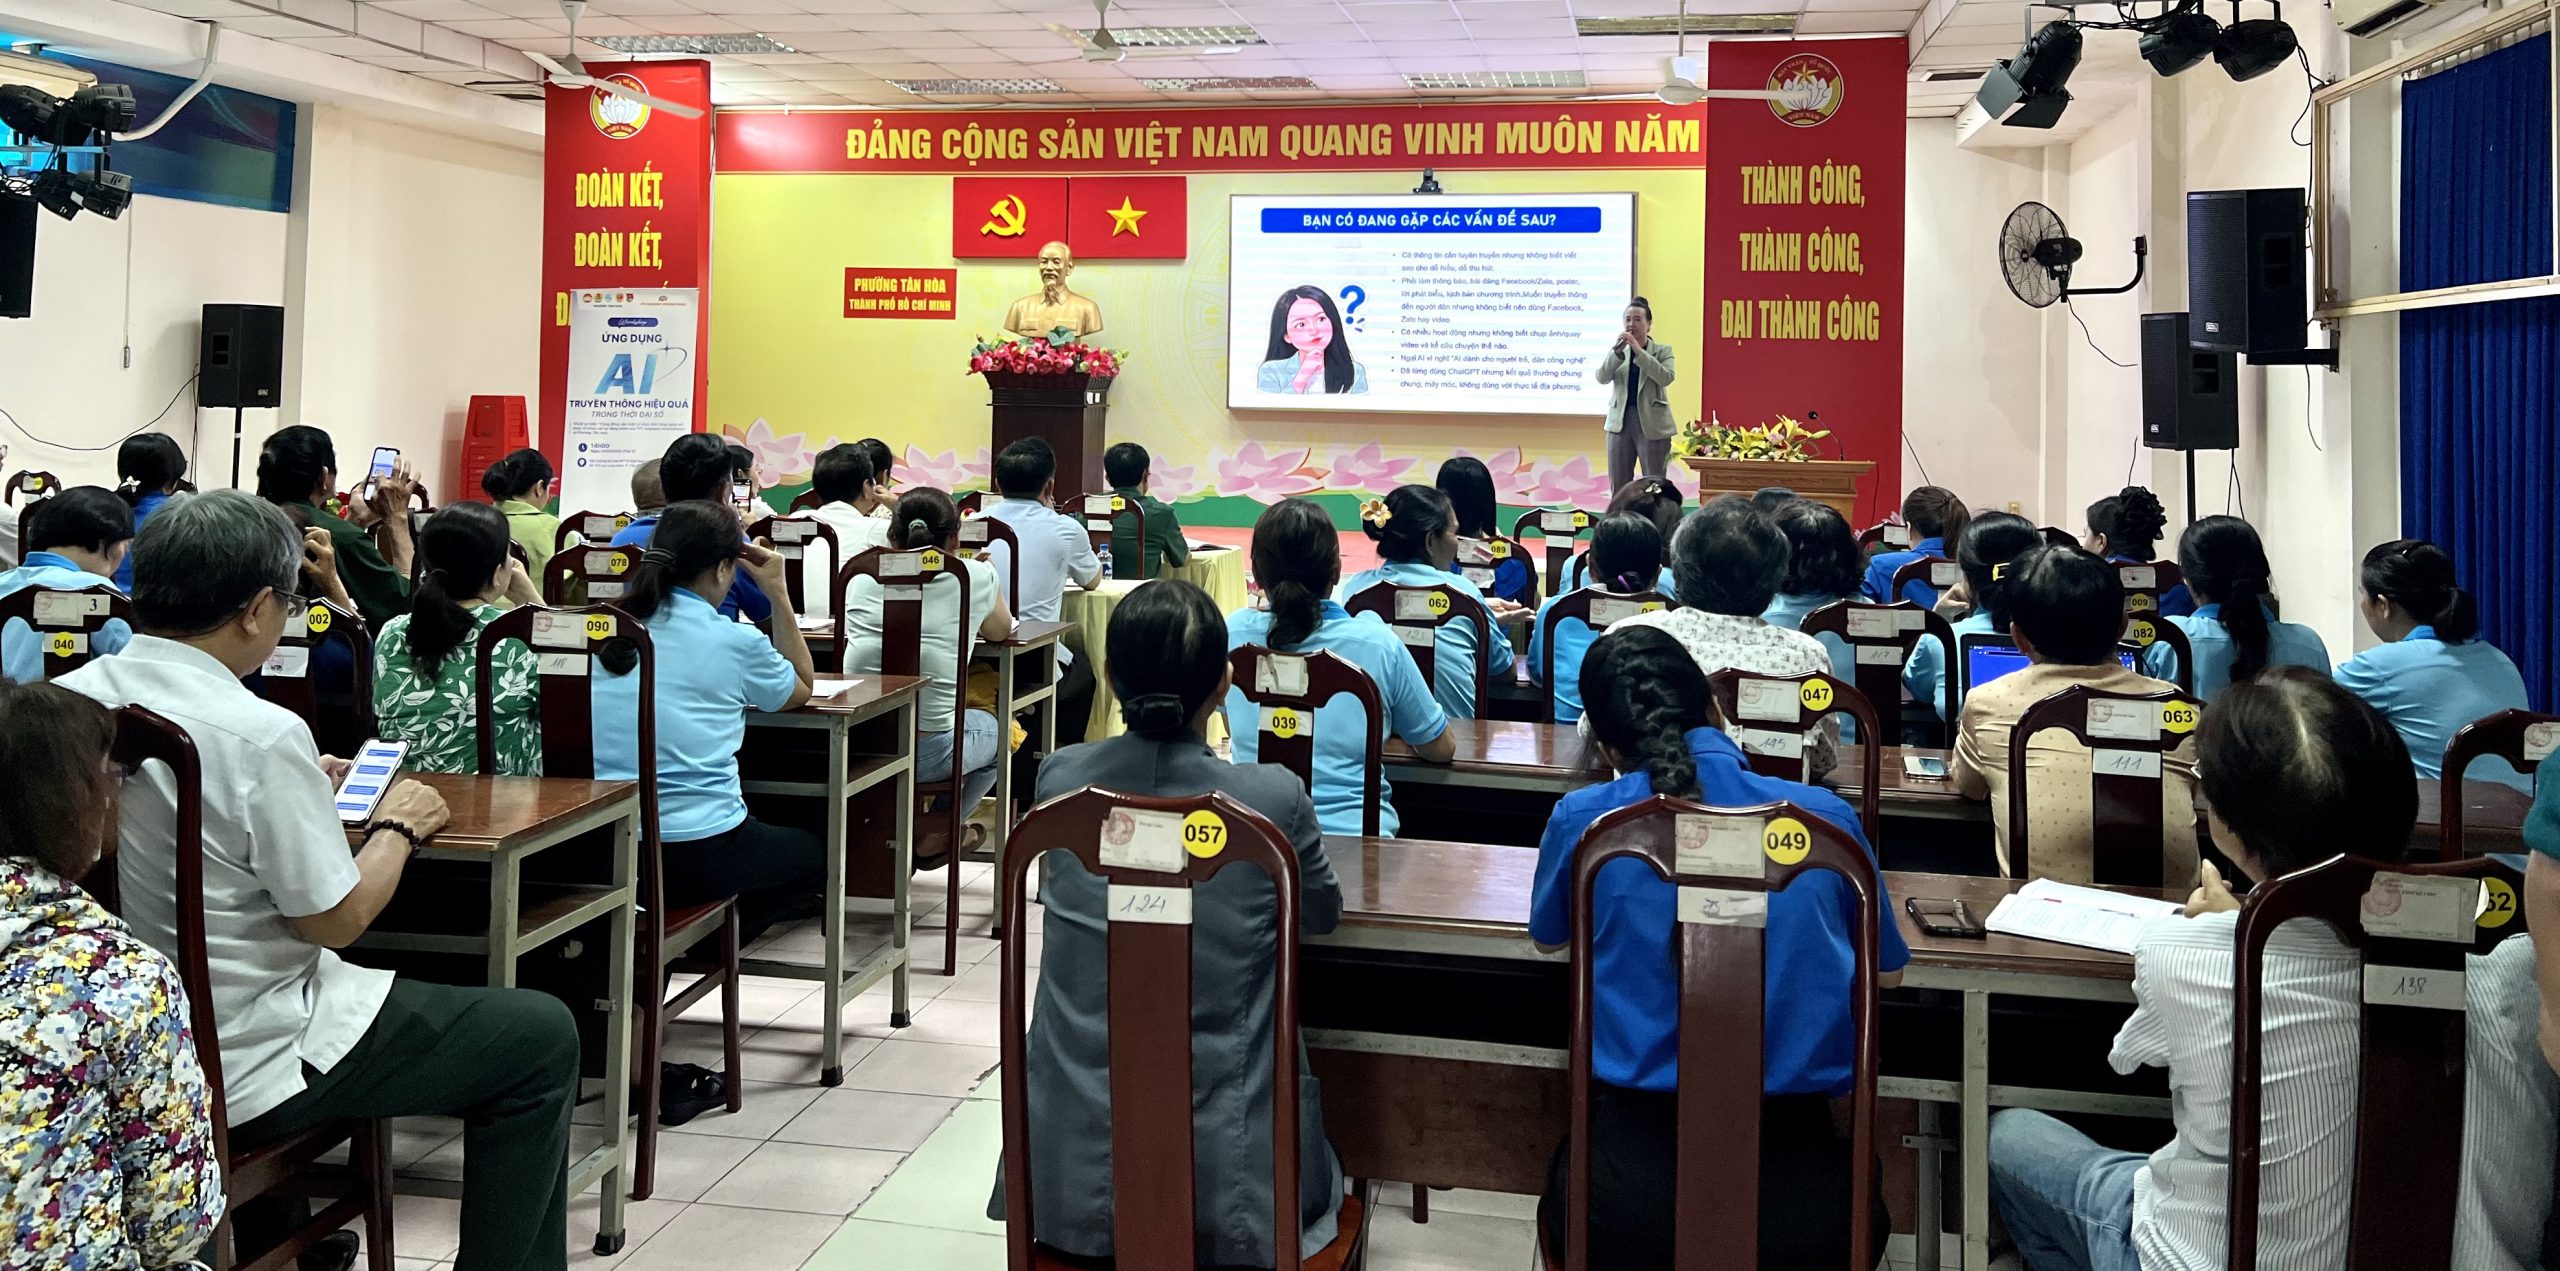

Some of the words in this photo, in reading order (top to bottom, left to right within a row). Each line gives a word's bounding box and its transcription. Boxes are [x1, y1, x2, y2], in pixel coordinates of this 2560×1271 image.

[846, 119, 931, 160] ĐẢNG
[942, 122, 1028, 166] CỘNG
[1038, 118, 1104, 160] SẢN
[1115, 120, 1181, 164] VIỆT
[1192, 125, 1268, 158] NAM
[1280, 123, 1392, 160] QUANG
[1404, 122, 1484, 156] VINH
[1496, 114, 1602, 155] MUÔN
[1615, 113, 1699, 153] NĂM
[576, 167, 624, 208] ĐOÀN
[630, 160, 663, 210] KẾT,
[1741, 160, 1802, 204] THÀNH
[1809, 158, 1865, 208] CÔNG,
[1303, 214, 1331, 230] BẠN
[1336, 212, 1353, 226] CÓ
[1358, 214, 1396, 226] ĐANG
[1401, 212, 1429, 229] GẶP
[1433, 212, 1460, 226] CÁC
[1464, 209, 1492, 226] VẤN
[1521, 214, 1556, 226] SAU?
[574, 227, 623, 267] ĐOÀN
[629, 221, 662, 270] KẾT,
[1739, 227, 1802, 272] THÀNH
[1808, 226, 1864, 276] CÔNG,
[854, 276, 897, 292] PHƯỜNG
[901, 276, 921, 292] TÂN
[924, 277, 946, 293] HÒA
[849, 297, 876, 310] THÀNH
[879, 296, 895, 310] PHỐ
[912, 298, 927, 311] CHÍ
[929, 300, 951, 311] MINH
[1721, 300, 1752, 346] ĐẠI
[1759, 294, 1820, 339] THÀNH
[1827, 293, 1879, 341] CÔNG
[630, 334, 662, 345] DỤNG
[595, 354, 658, 394] AI
[609, 399, 641, 408] THÔNG
[1491, 545, 1506, 554] 089
[611, 558, 627, 567] 078
[922, 555, 939, 564] 046
[89, 599, 98, 611] 3
[1428, 598, 1447, 609] 062
[309, 613, 328, 625] 002
[586, 620, 610, 631] 090
[2133, 627, 2153, 638] 082
[54, 639, 75, 650] 040
[1803, 688, 1829, 703] 047
[1272, 717, 1297, 729] 039
[2163, 711, 2193, 724] 063
[1184, 825, 1223, 845] 057
[1766, 832, 1806, 851] 049
[2485, 892, 2513, 912] 52
